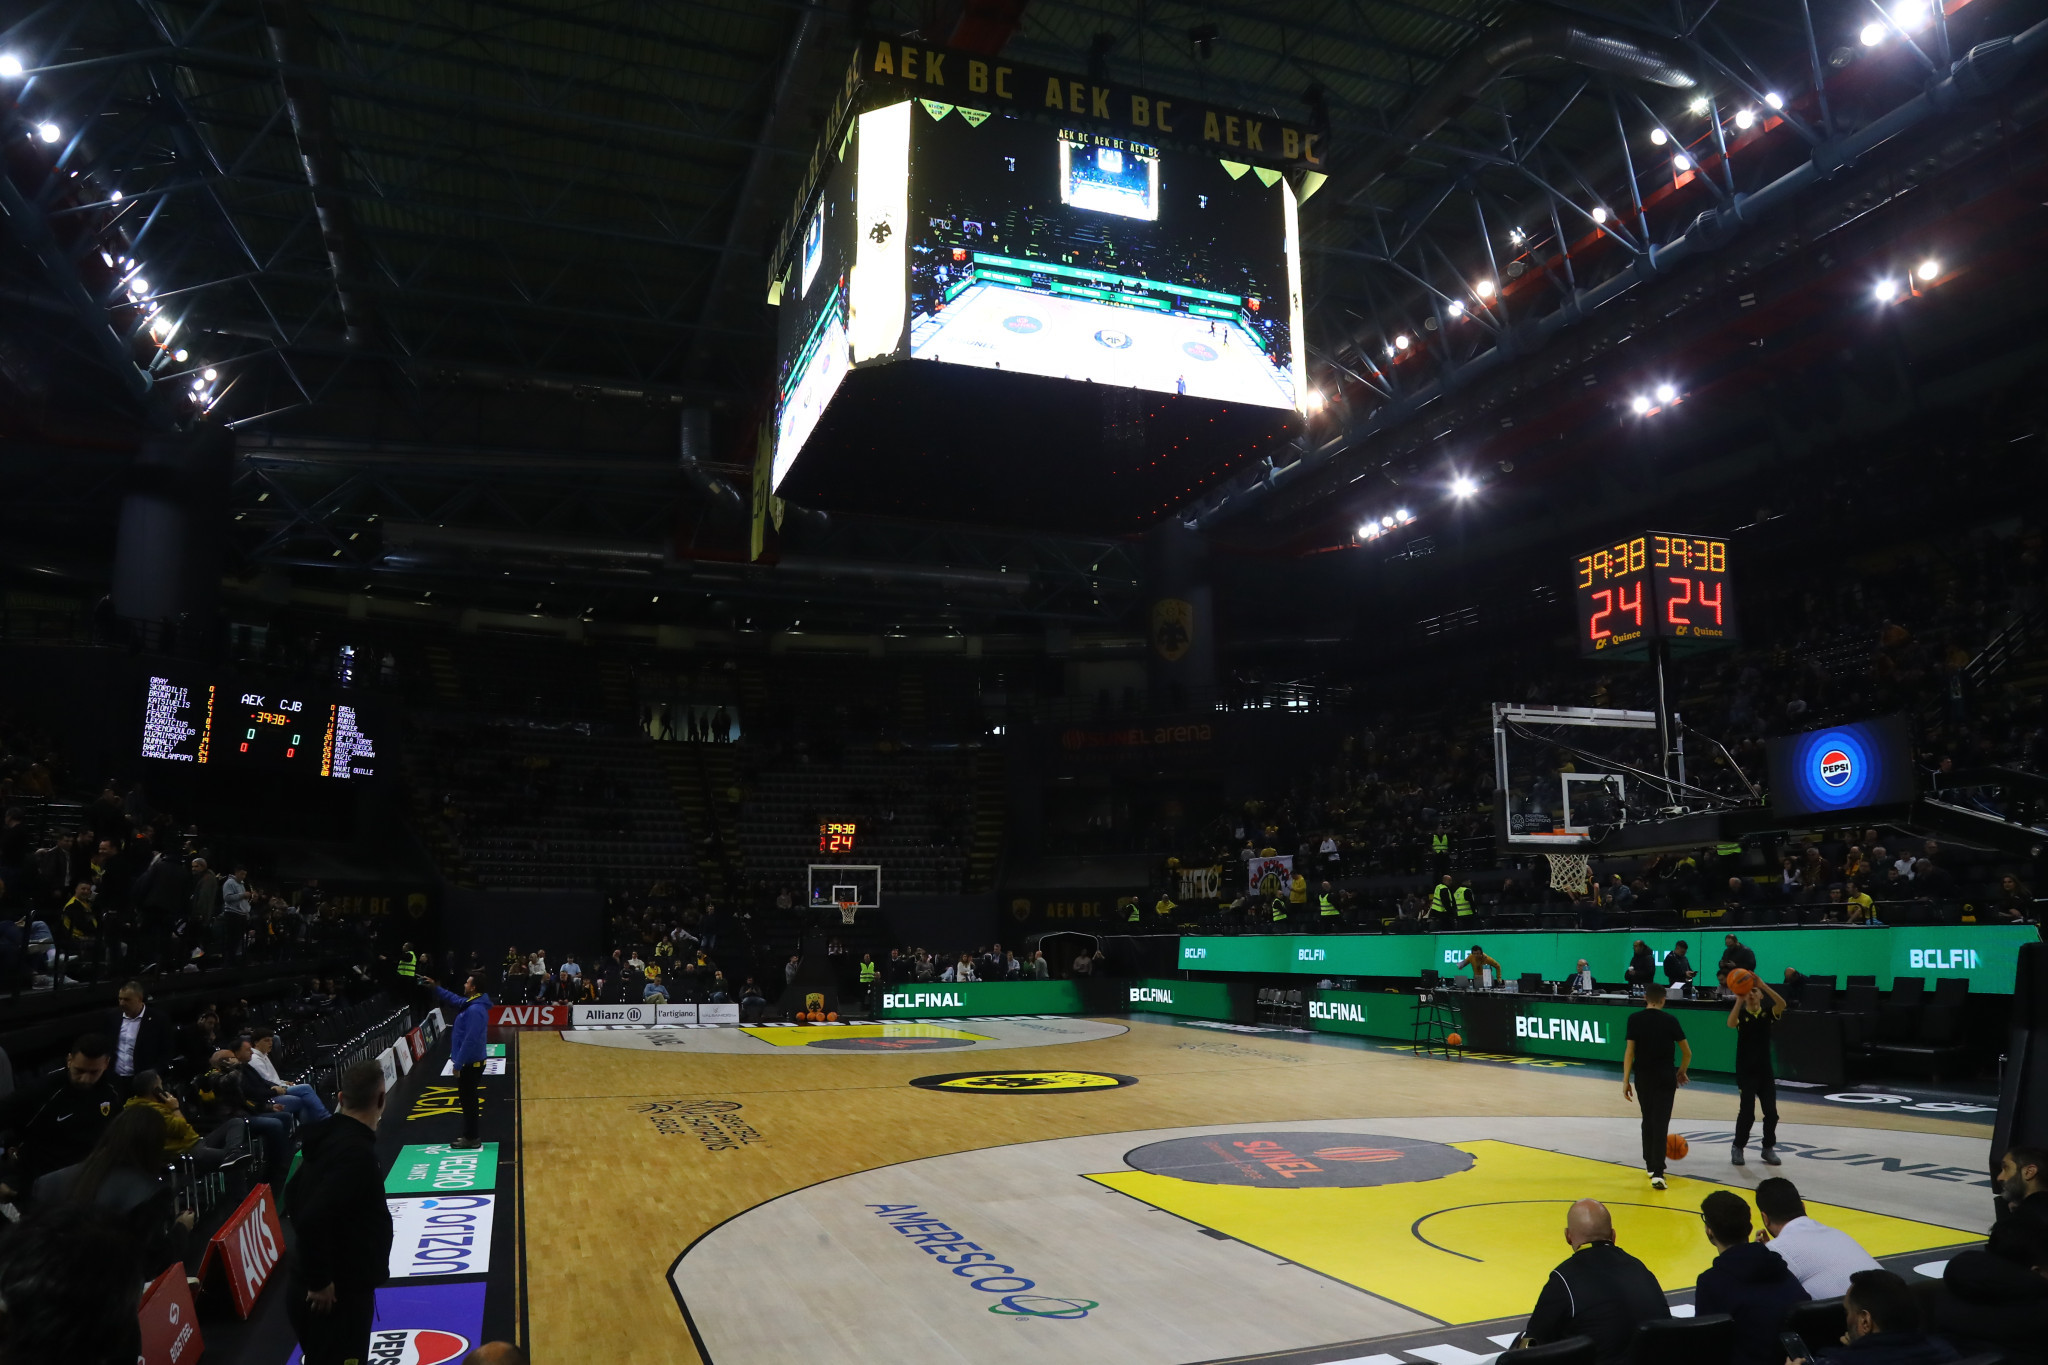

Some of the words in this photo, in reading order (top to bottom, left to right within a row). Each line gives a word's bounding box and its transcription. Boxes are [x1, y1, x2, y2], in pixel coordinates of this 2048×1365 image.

[874, 41, 945, 86] AEK
[968, 60, 1013, 100] BC
[1045, 77, 1110, 120] AEK
[1132, 95, 1172, 132] BC
[1204, 112, 1263, 152] AEK
[1282, 127, 1320, 164] BC
[1059, 129, 1074, 140] AEK
[1078, 132, 1090, 144] BC
[1094, 135, 1110, 147] AEK
[1113, 139, 1124, 150] BC
[1130, 142, 1146, 155] AEK
[1148, 147, 1159, 158] BC
[1578, 537, 1646, 589] 39:38
[1654, 536, 1725, 572] 39:38
[1590, 581, 1642, 640] 24
[1669, 577, 1722, 625] 24
[1612, 630, 1641, 645] Quince
[1694, 626, 1723, 636] Quince
[150, 676, 168, 684] GRAY
[241, 694, 266, 706] AEK
[280, 700, 302, 712] CJB
[256, 712, 286, 726] 39:38
[246, 728, 256, 740] 0
[292, 734, 300, 746] 0
[1154, 724, 1212, 744] arena
[240, 742, 248, 752] 0
[286, 748, 294, 758] 0
[1822, 762, 1848, 774] PEPSI
[827, 824, 856, 834] 39:38
[830, 836, 852, 850] 24
[1046, 904, 1075, 918] AEK
[1082, 904, 1101, 918] BC
[884, 992, 964, 1008] BCLFINAL
[1130, 988, 1172, 1004] BCLFINAL
[498, 1006, 554, 1025] AVIS
[586, 1010, 624, 1020] Allianz
[1310, 1001, 1366, 1022] BCLFINAL
[1516, 1016, 1606, 1044] BCLFINAL
[681, 1116, 740, 1150] CHAMPIONS
[1234, 1140, 1325, 1179] SUNEL
[407, 1163, 430, 1180] PAINTS
[432, 1154, 478, 1189] VECHRO
[239, 1198, 278, 1300] AVIS
[864, 1204, 1036, 1292] AMERESCO
[170, 1322, 194, 1364] BIOSTEEL
